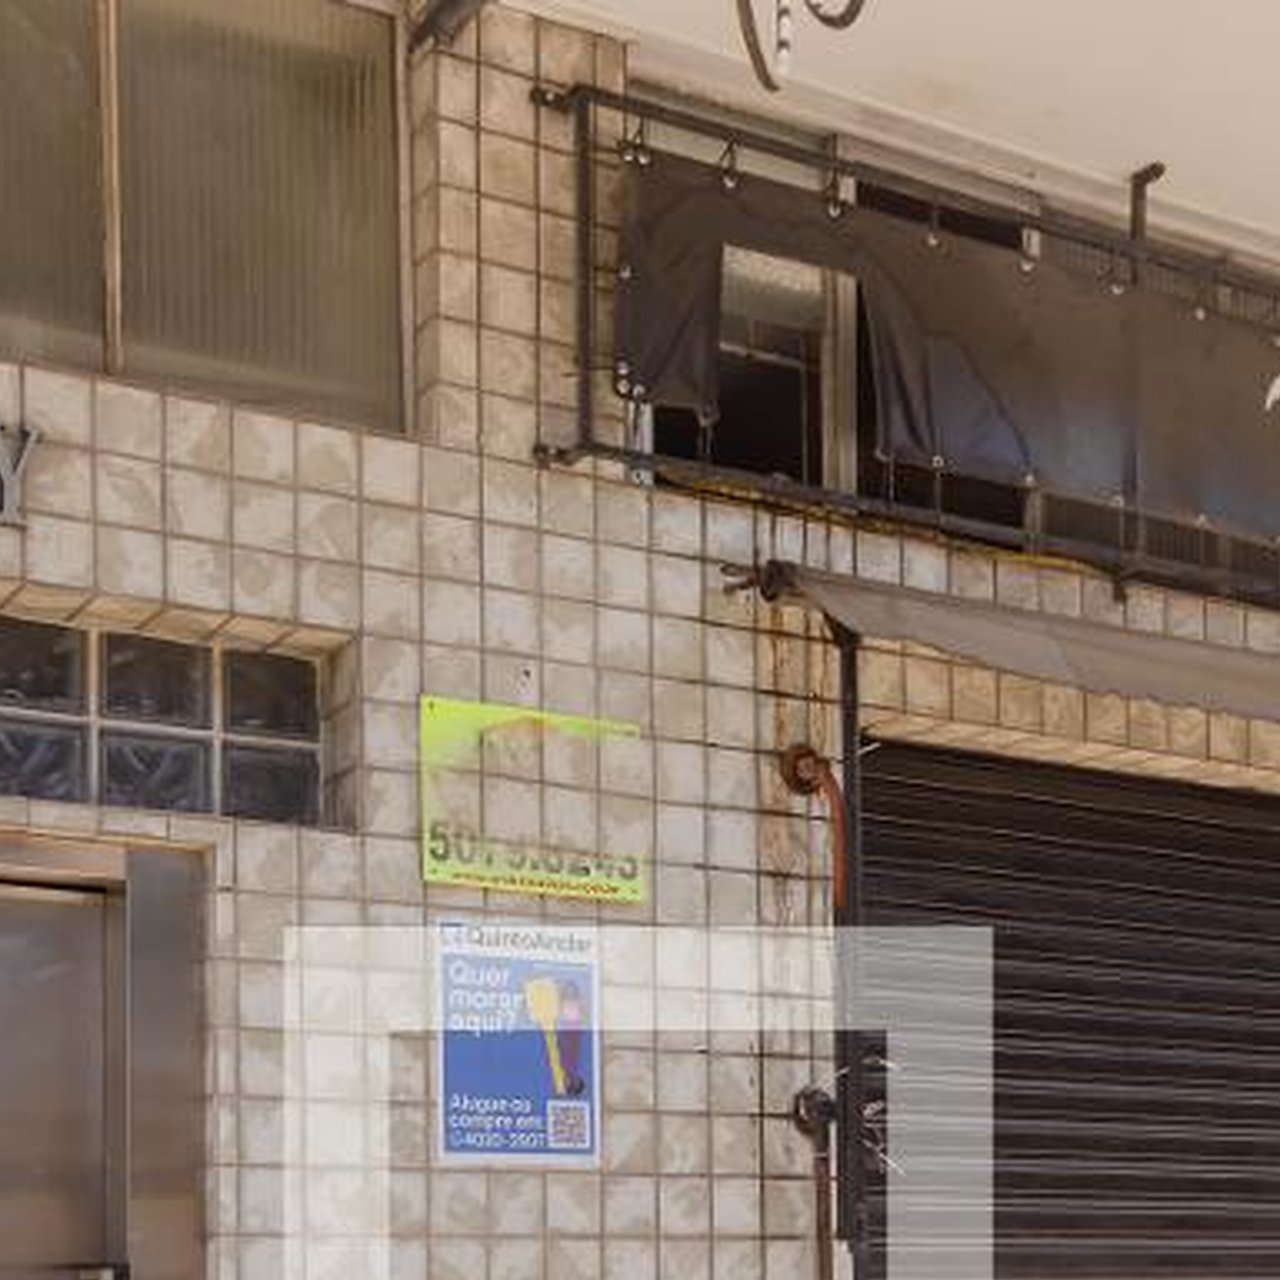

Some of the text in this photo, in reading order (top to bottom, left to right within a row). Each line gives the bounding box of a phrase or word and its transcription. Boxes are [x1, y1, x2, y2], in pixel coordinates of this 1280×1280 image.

[449, 960, 511, 988] Quer
[449, 988, 524, 1010] morar
[450, 1008, 517, 1037] aqui?
